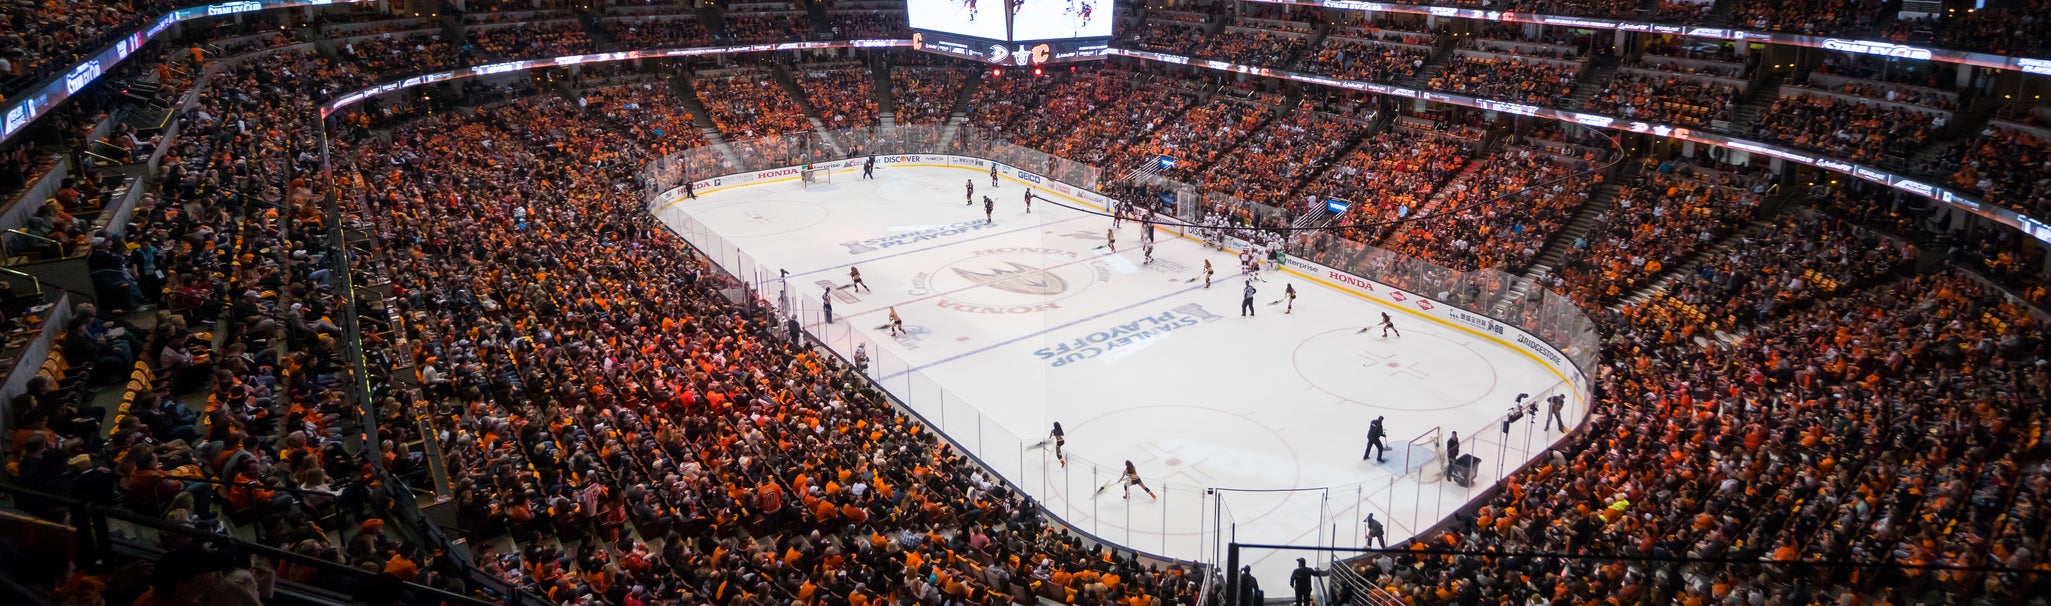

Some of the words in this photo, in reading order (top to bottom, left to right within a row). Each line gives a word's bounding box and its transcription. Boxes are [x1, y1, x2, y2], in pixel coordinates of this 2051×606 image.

[884, 155, 920, 164] DISCOVER
[758, 168, 798, 179] HONDA
[1018, 171, 1041, 184] GEICO
[863, 225, 947, 244] STANLEY
[949, 218, 991, 229] CUP
[880, 222, 997, 248] PLAYOFFS
[973, 247, 1077, 258] HONDA
[909, 271, 929, 296] Center
[1329, 271, 1375, 291] HONDA
[936, 299, 1062, 314] HONDA
[1033, 311, 1177, 360] PLAYOFFS
[1107, 315, 1198, 351] STANLEY
[1051, 347, 1103, 368] CUP
[1517, 333, 1562, 366] BRIDGESTONE
